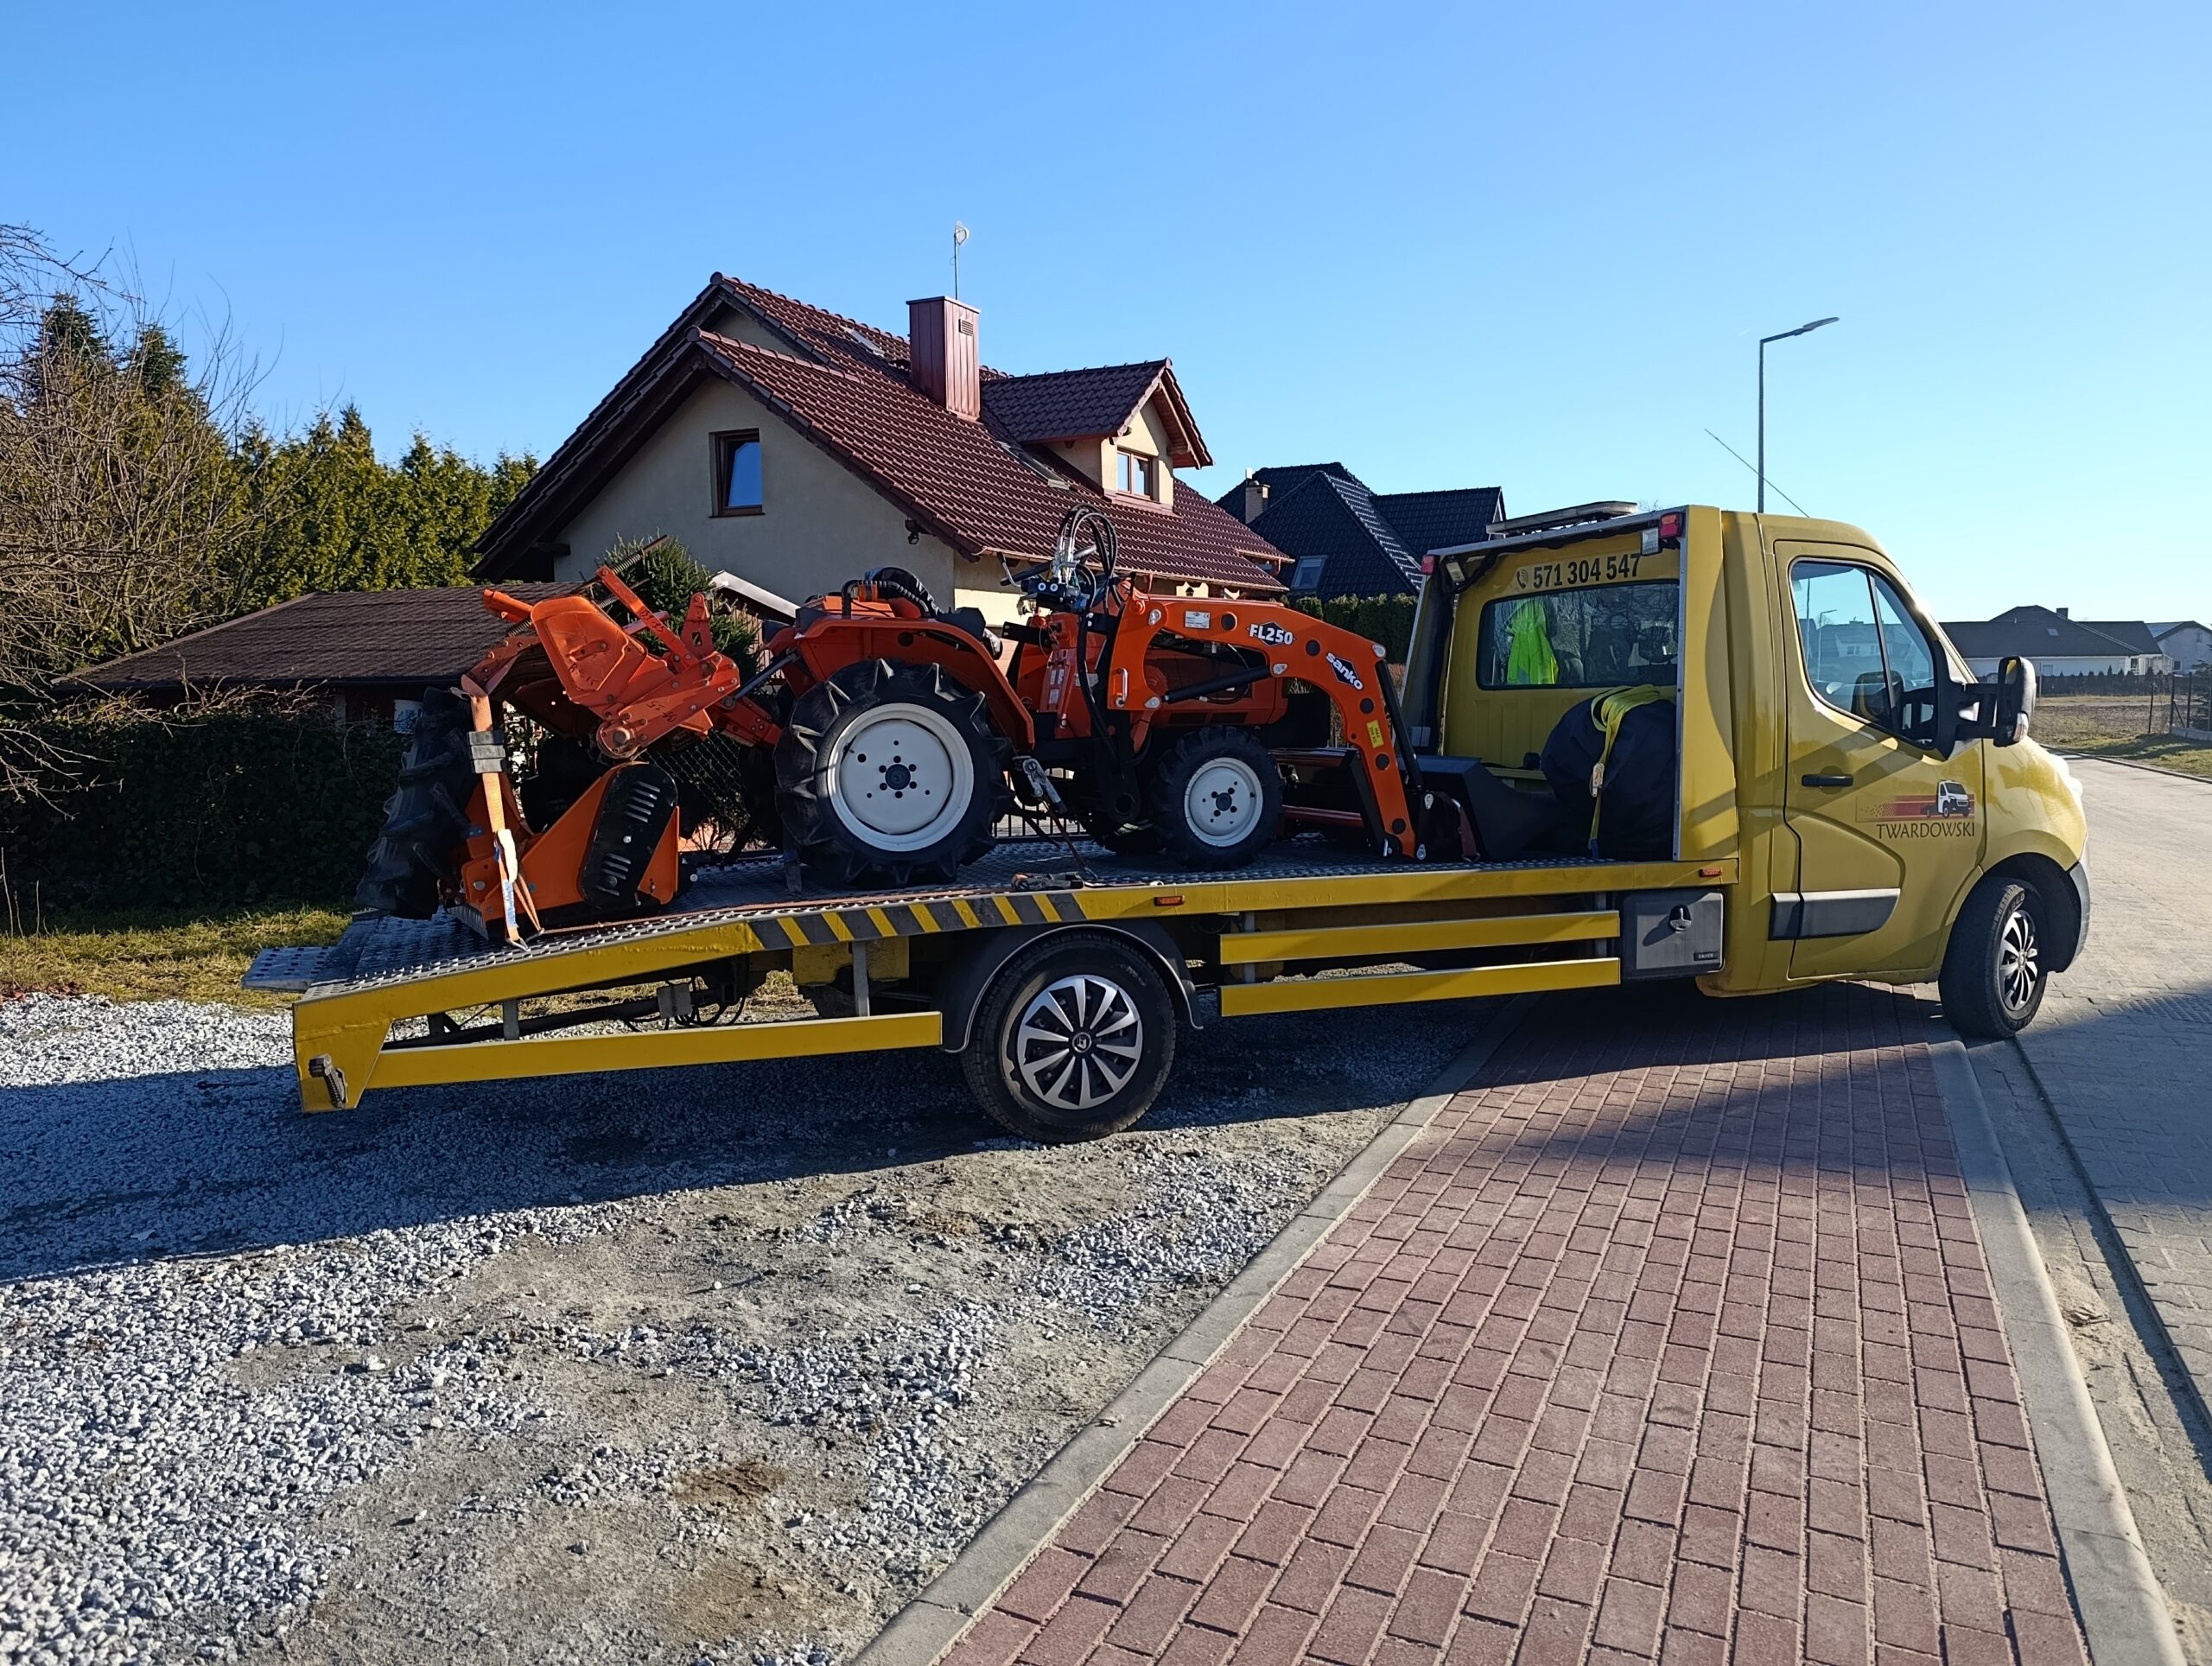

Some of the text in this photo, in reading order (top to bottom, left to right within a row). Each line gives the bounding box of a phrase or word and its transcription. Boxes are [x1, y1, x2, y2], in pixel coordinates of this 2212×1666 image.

[1533, 554, 1641, 588] 571 304 547
[1249, 624, 1294, 645] FL250
[1325, 652, 1363, 690] sanko
[1876, 823, 1975, 839] TWARDOWSKI
